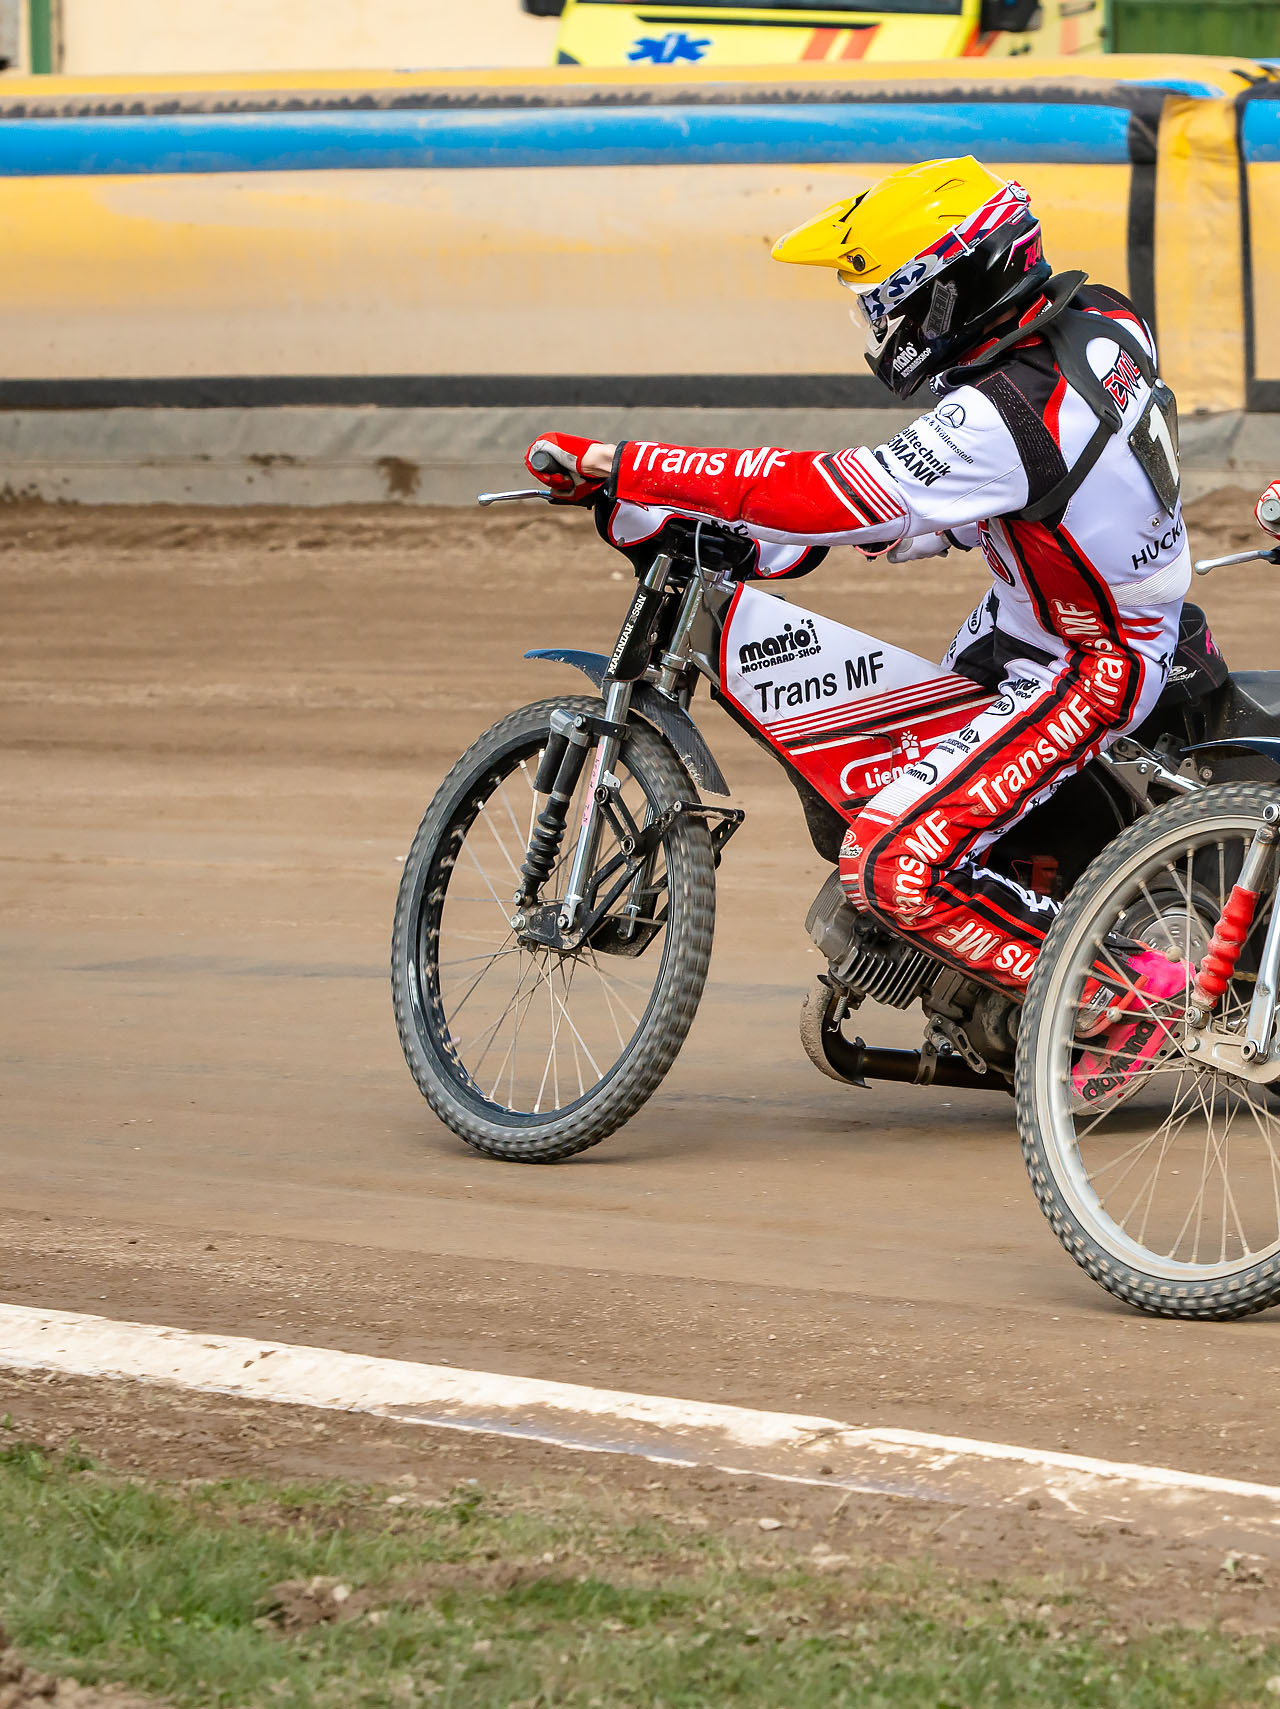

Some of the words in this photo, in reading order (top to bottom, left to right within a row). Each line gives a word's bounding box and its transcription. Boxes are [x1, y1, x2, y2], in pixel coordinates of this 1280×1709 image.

[632, 441, 728, 477] Trans
[734, 446, 793, 479] MF
[1054, 601, 1102, 635] MF
[741, 645, 822, 674] MOTORRAD-SHOP
[754, 670, 838, 713] Trans
[844, 651, 884, 691] MF
[968, 740, 1059, 814] Trans
[1046, 694, 1093, 753] MF
[904, 809, 951, 864] MF
